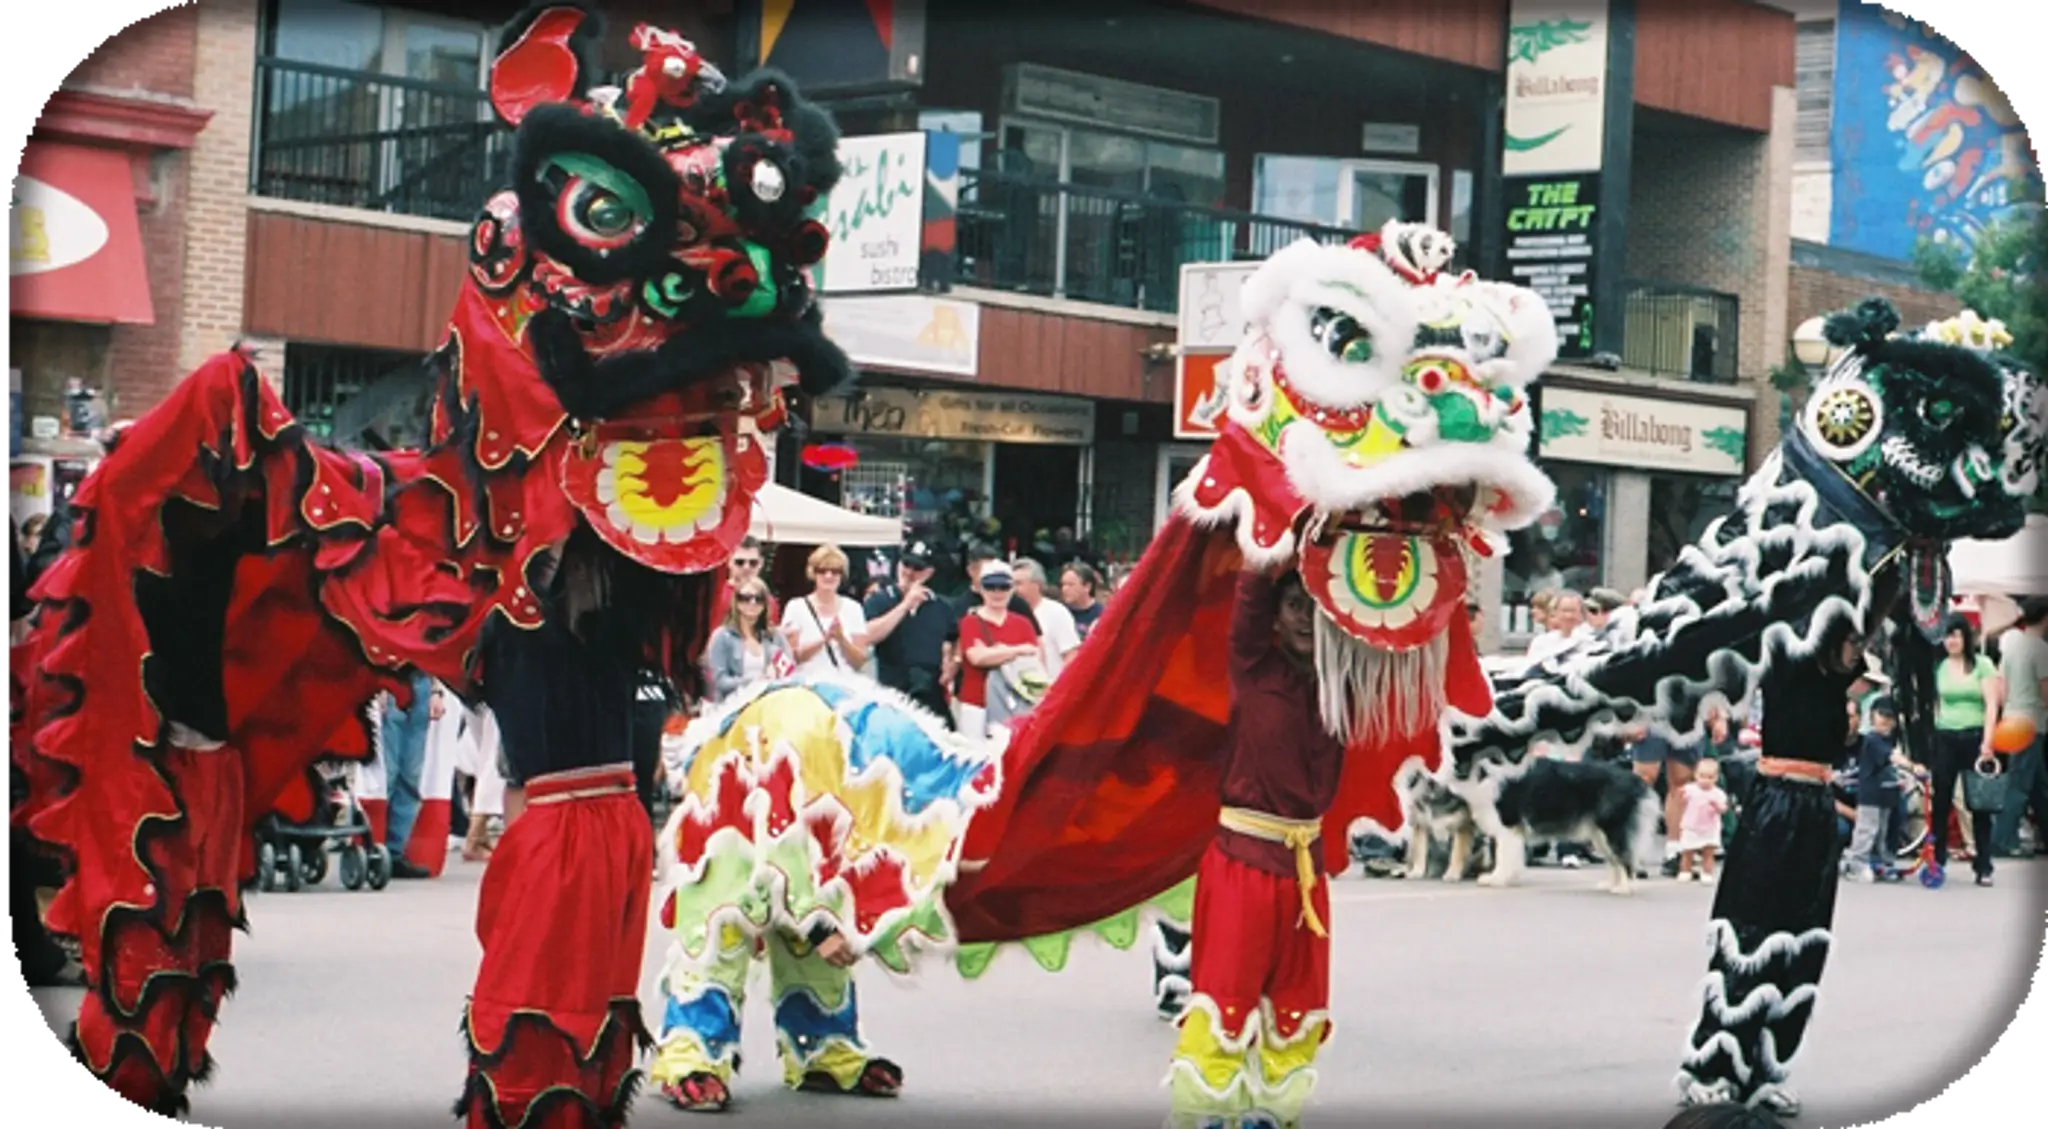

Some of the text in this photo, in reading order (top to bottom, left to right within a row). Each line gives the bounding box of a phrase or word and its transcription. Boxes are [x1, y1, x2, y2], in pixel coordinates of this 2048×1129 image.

[1515, 75, 1598, 97] Billabong
[1527, 181, 1580, 206] THE
[860, 235, 899, 259] sushi
[1600, 404, 1693, 452] Billabong
